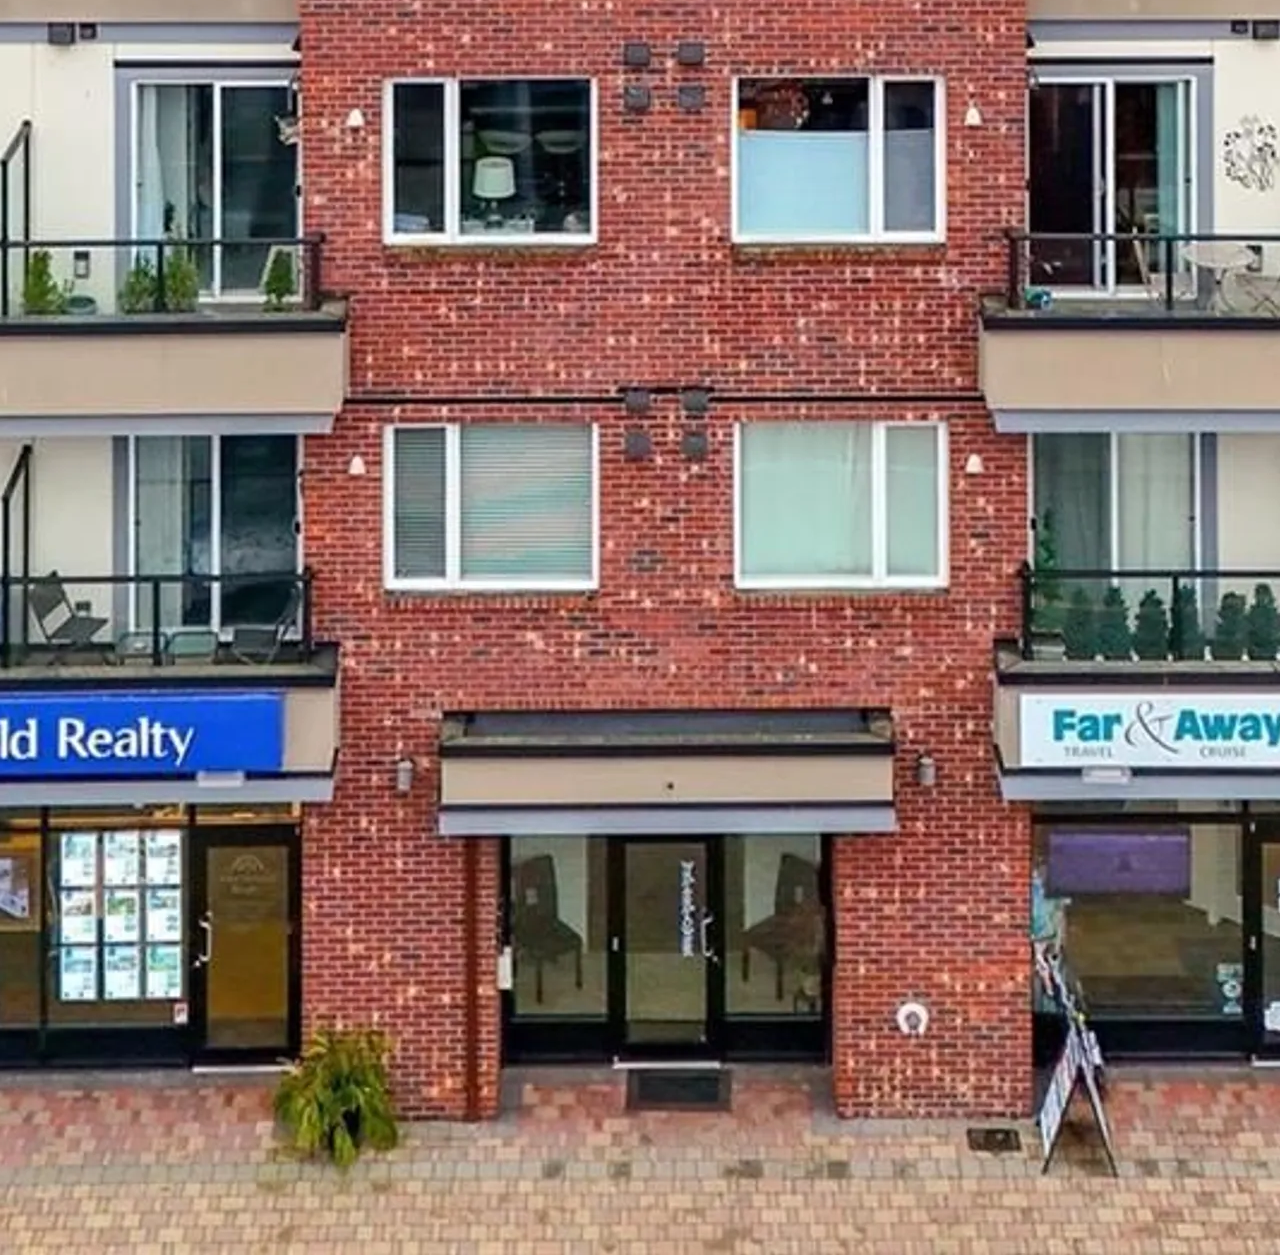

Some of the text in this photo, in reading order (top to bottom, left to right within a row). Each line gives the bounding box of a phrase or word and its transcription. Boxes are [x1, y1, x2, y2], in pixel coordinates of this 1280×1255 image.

[57, 717, 194, 767] Realty
[1053, 709, 1122, 742] Far
[1124, 701, 1179, 755] &
[1064, 746, 1113, 758] TRAVEL
[1200, 746, 1247, 758] CRUISE
